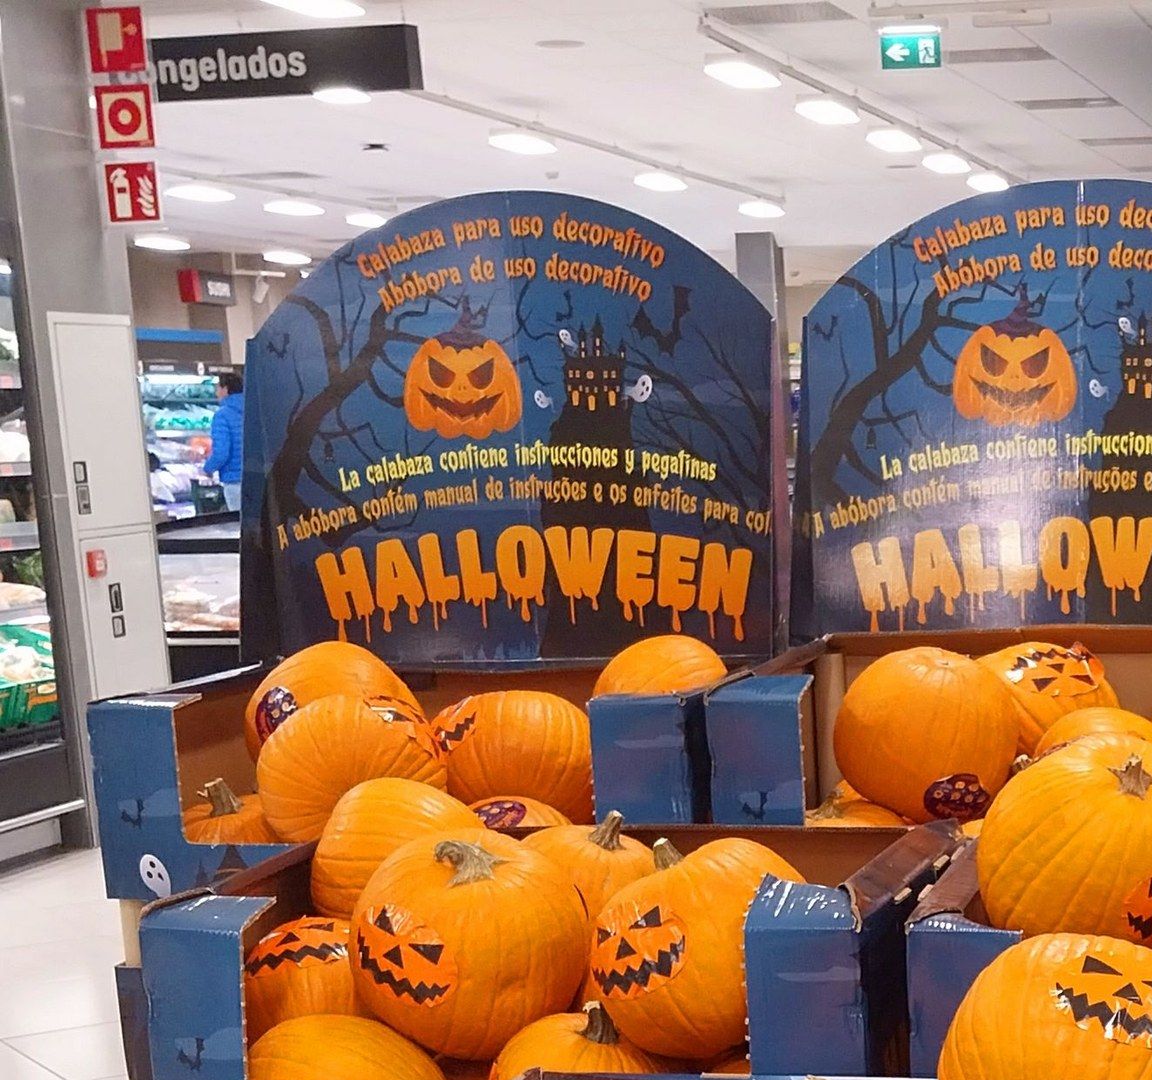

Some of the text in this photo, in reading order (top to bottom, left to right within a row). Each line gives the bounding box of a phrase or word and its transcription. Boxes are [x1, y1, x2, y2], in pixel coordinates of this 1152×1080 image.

[357, 211, 666, 279] Calabaza para uso decorativo
[913, 214, 1007, 263] Calabaza
[1015, 205, 1065, 237] para
[1075, 203, 1110, 227] uso
[378, 252, 653, 313] Abóbora de uso decorativo
[932, 252, 1021, 298] Abóbora
[1030, 243, 1056, 272] de
[1066, 244, 1099, 268] uso
[338, 439, 717, 492] La calabaza contiene instrucciones y pegatinas
[880, 455, 903, 481] La
[908, 441, 979, 473] calabaza
[986, 432, 1057, 461] contiene
[276, 473, 773, 551] A abóbora contém manual de instruções e os enfeites para col
[812, 511, 825, 539] A
[829, 493, 897, 530] abóbora
[903, 474, 960, 509] contém
[967, 469, 1023, 497] manual
[1031, 466, 1051, 490] de
[1058, 463, 1137, 494] instruções
[315, 524, 753, 641] HALLOWEEN
